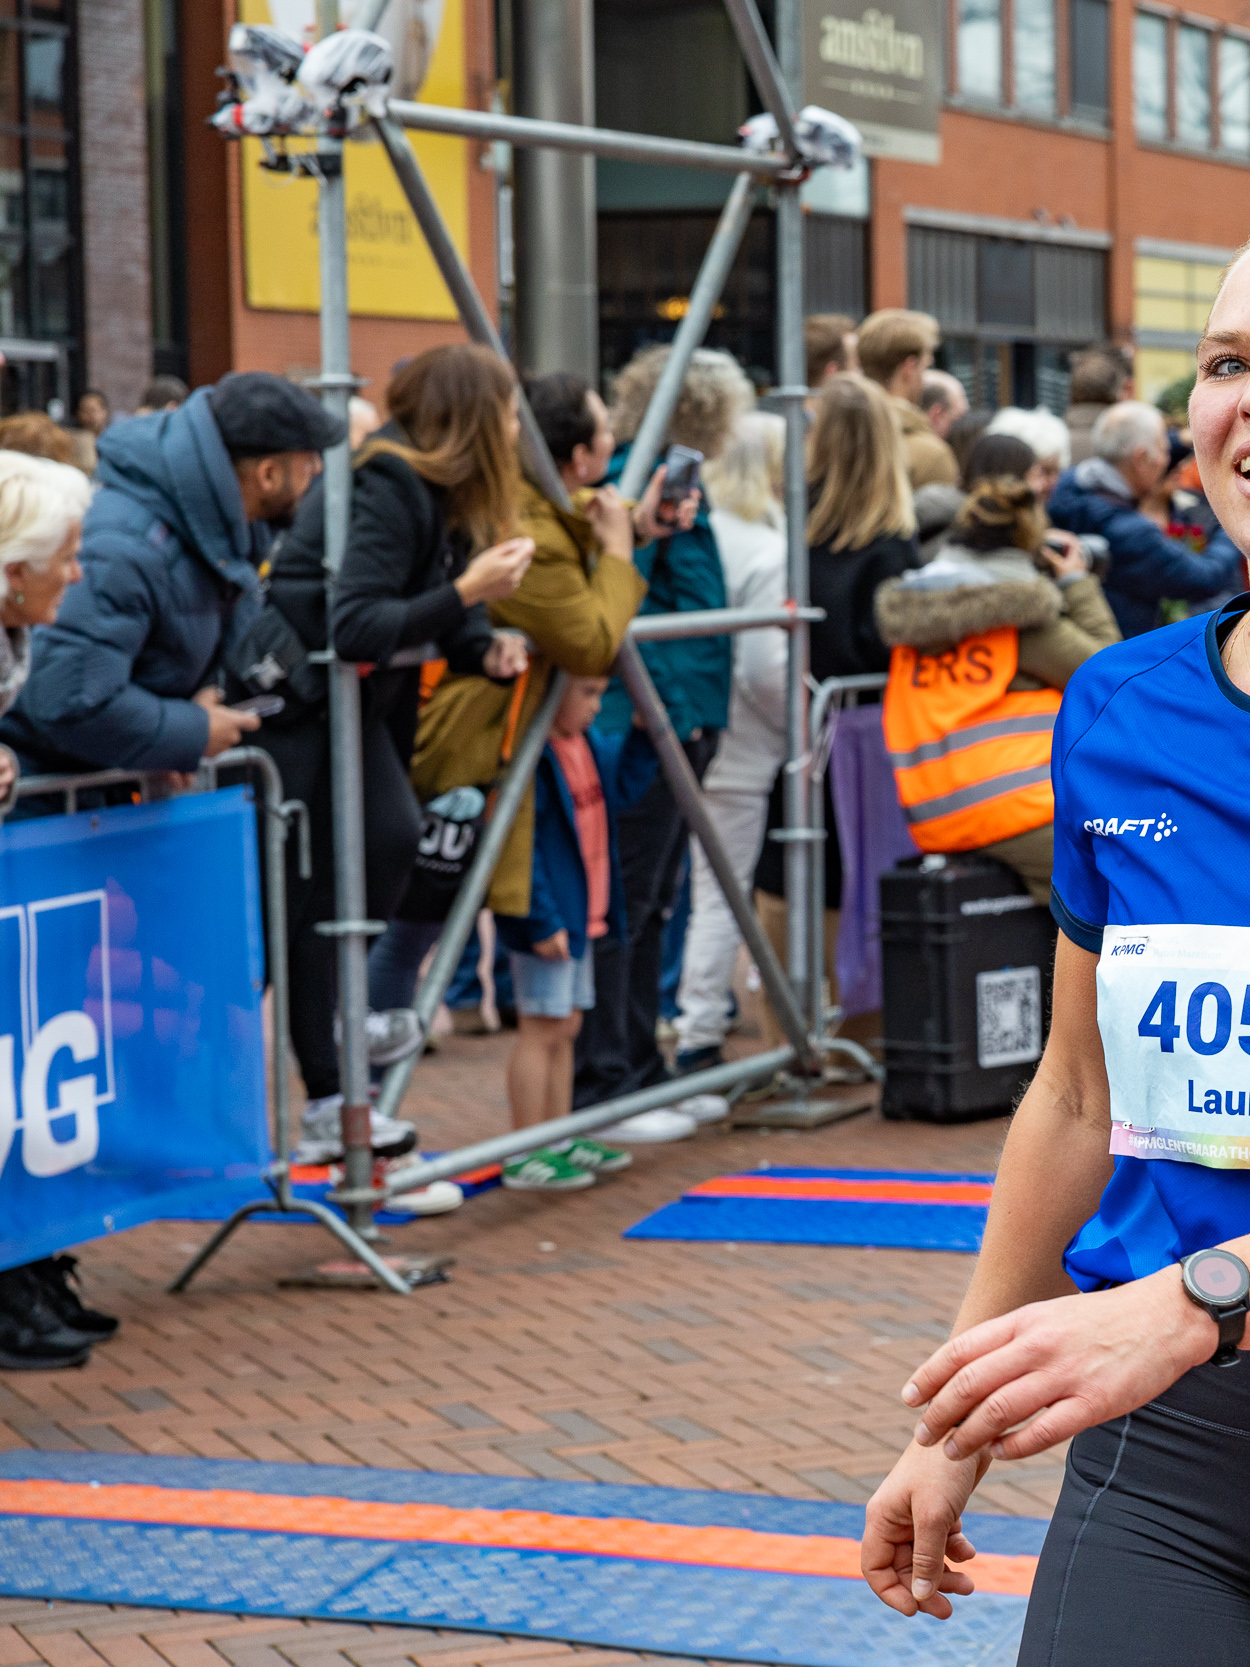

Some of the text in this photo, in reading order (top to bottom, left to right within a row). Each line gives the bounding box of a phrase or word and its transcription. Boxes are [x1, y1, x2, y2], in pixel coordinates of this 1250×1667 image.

[1083, 817, 1156, 838] CRAFT
[1111, 943, 1145, 956] KPMG
[0, 1010, 99, 1178] G
